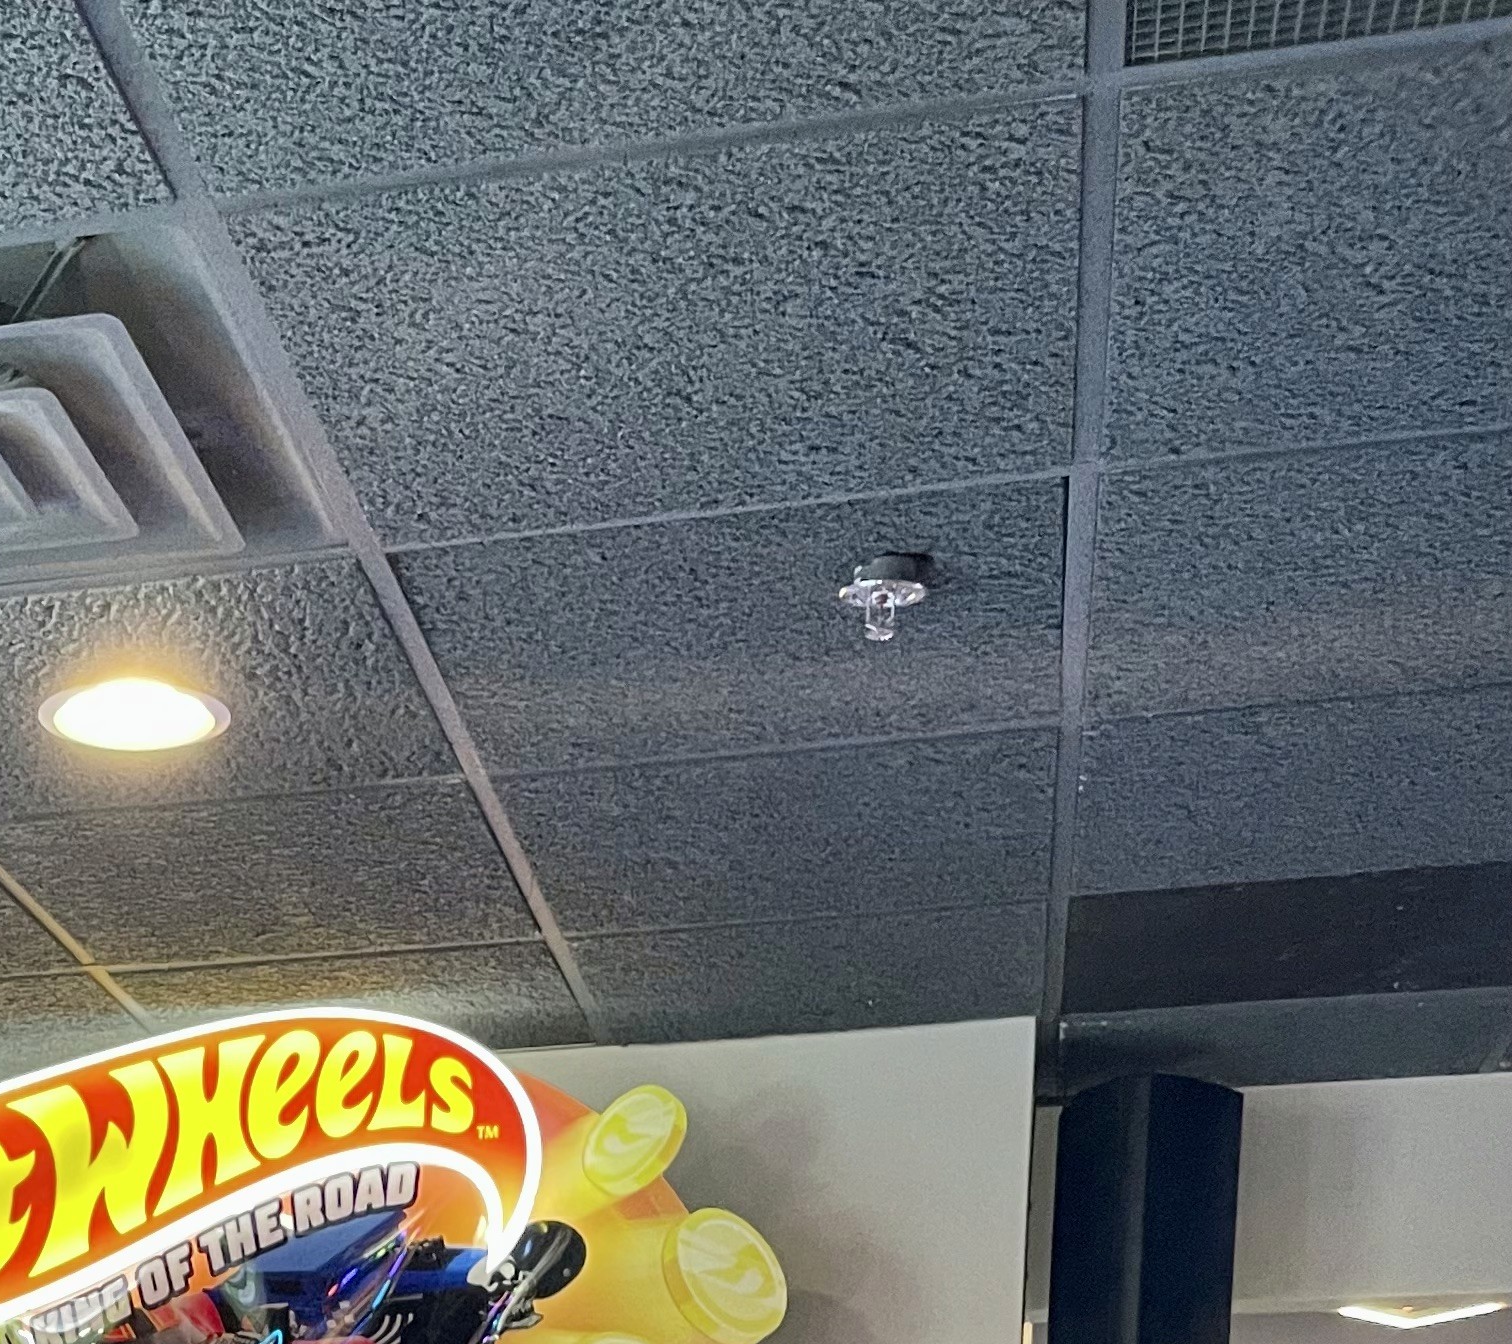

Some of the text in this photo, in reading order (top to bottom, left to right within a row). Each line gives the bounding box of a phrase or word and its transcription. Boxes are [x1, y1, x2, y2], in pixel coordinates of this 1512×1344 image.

[135, 1239, 194, 1310] OF
[197, 1197, 288, 1278] THE
[290, 1161, 421, 1237] ROAD
